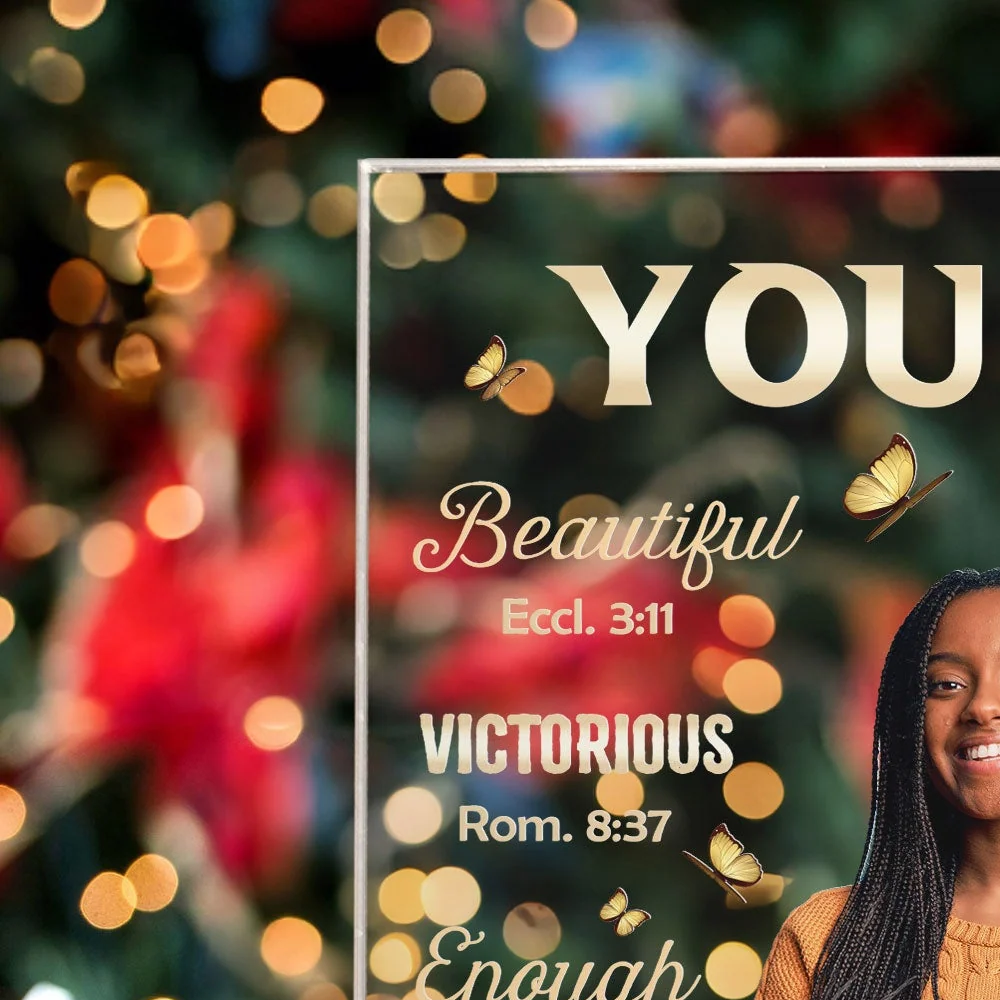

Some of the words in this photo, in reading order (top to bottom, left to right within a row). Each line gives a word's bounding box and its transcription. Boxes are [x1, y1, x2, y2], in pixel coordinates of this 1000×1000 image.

[545, 263, 983, 408] YOU
[412, 480, 803, 591] Beautiful
[501, 596, 596, 636] Eccl.
[609, 599, 675, 636] 3:11
[419, 712, 735, 776] VICTORIOUS
[458, 805, 573, 843] Rom.
[586, 808, 672, 844] 8:37
